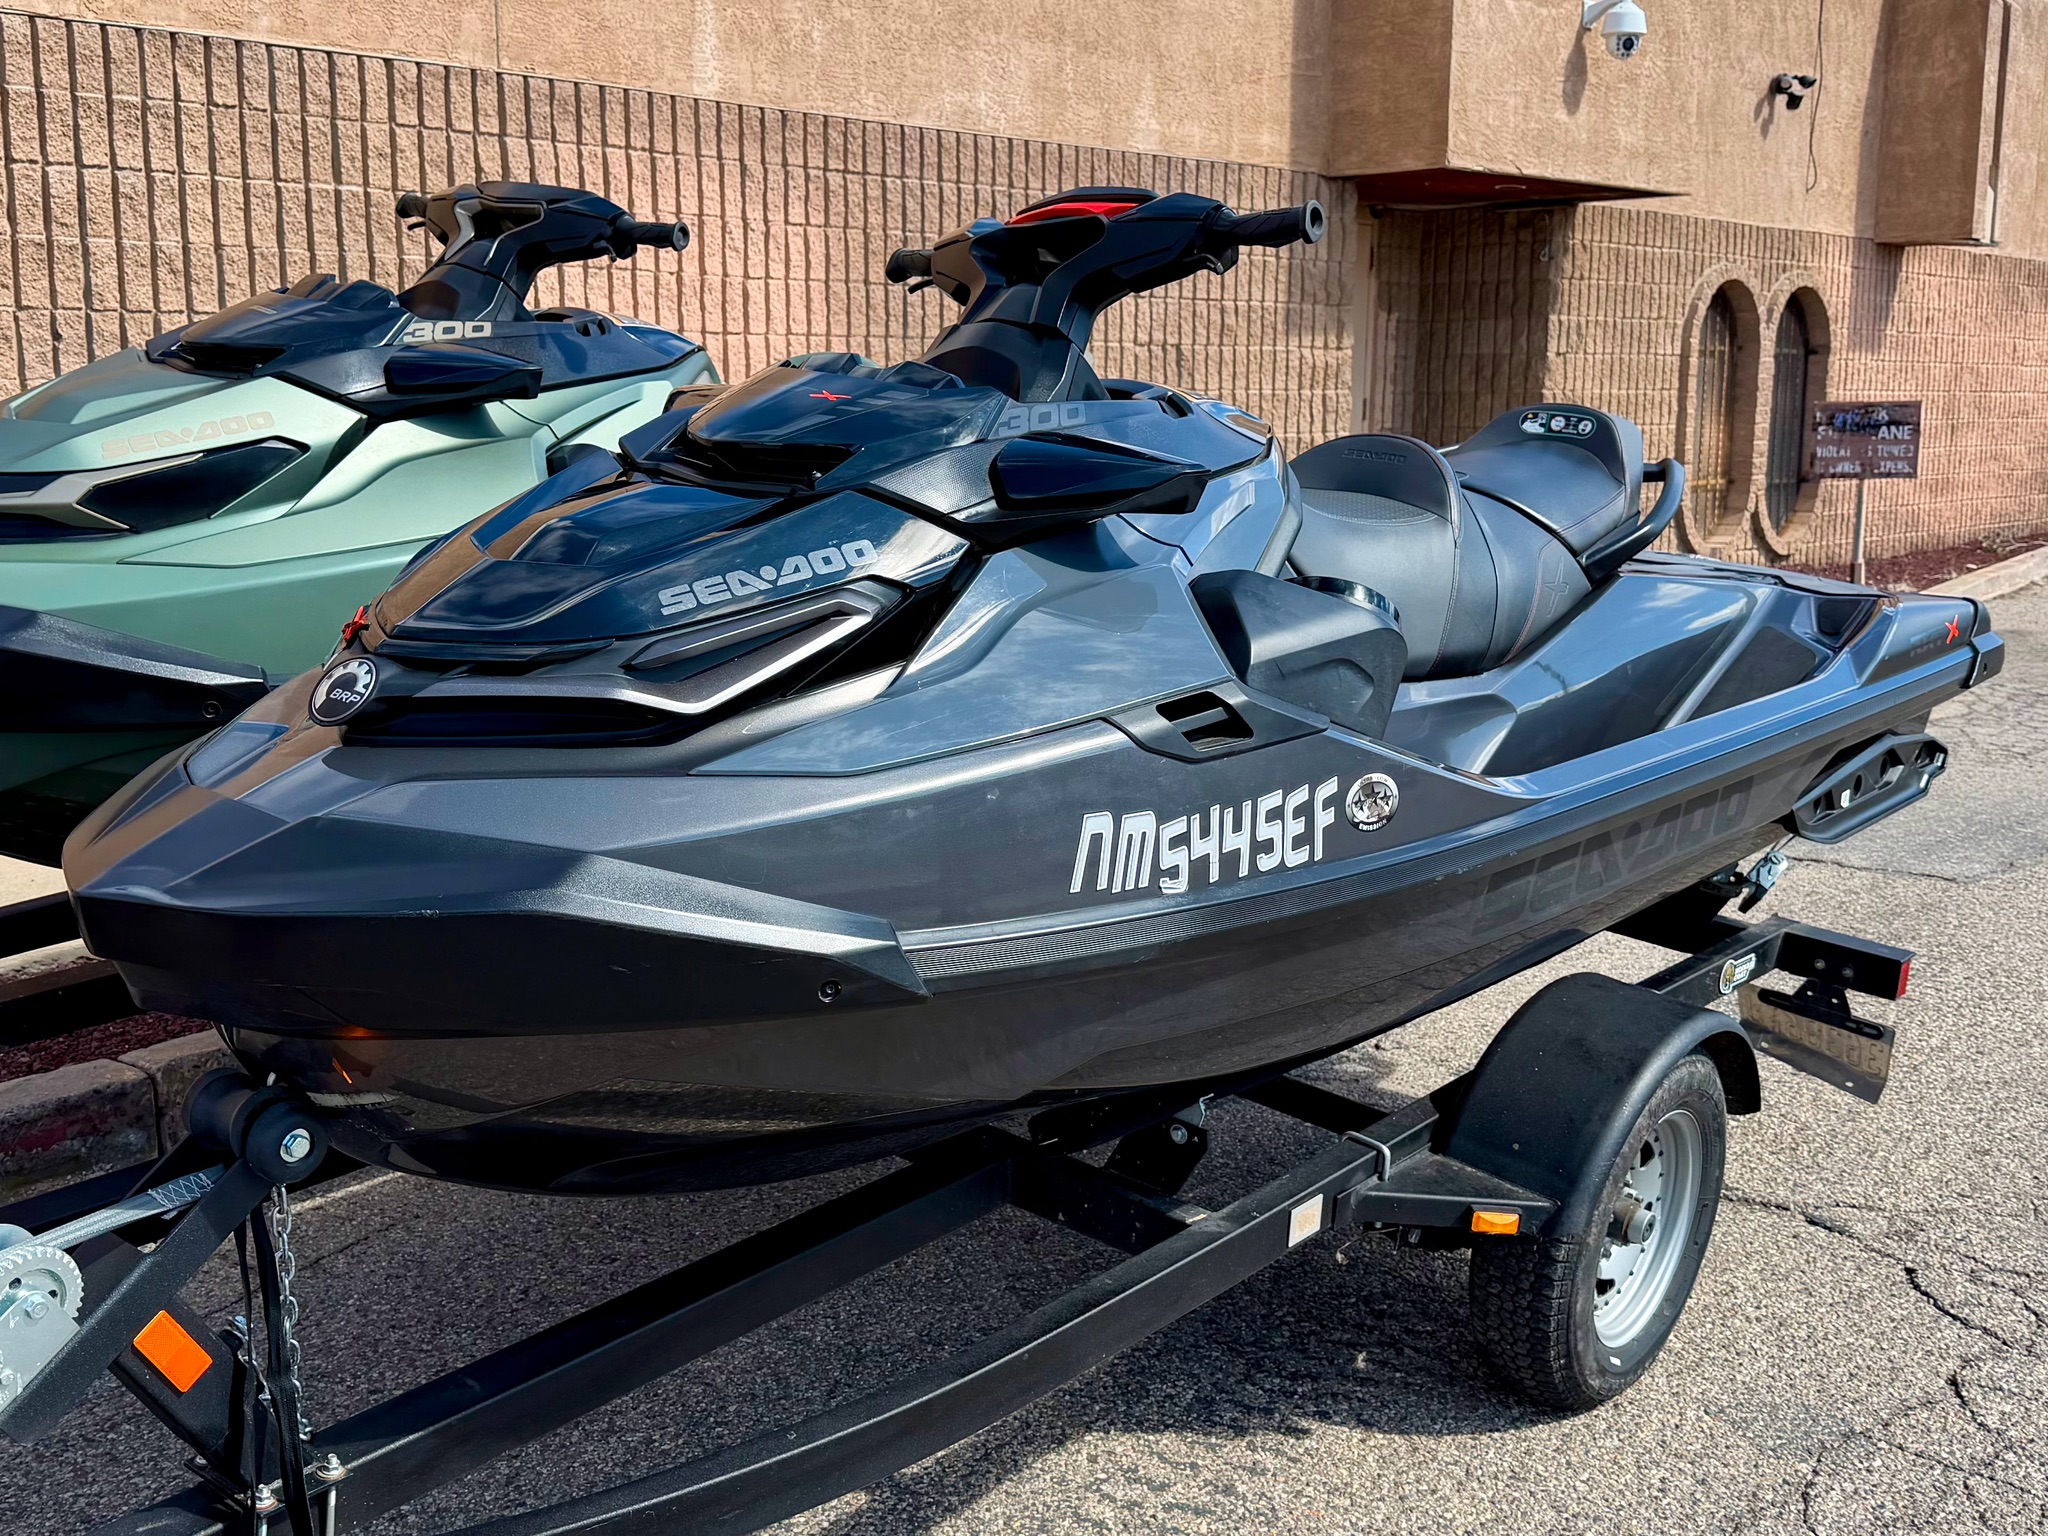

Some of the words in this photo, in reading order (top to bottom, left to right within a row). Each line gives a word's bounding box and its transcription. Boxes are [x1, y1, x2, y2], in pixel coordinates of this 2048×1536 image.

[403, 320, 492, 343] 300
[998, 403, 1086, 437] 300
[1871, 425, 1914, 440] ANE
[329, 688, 361, 703] BRP
